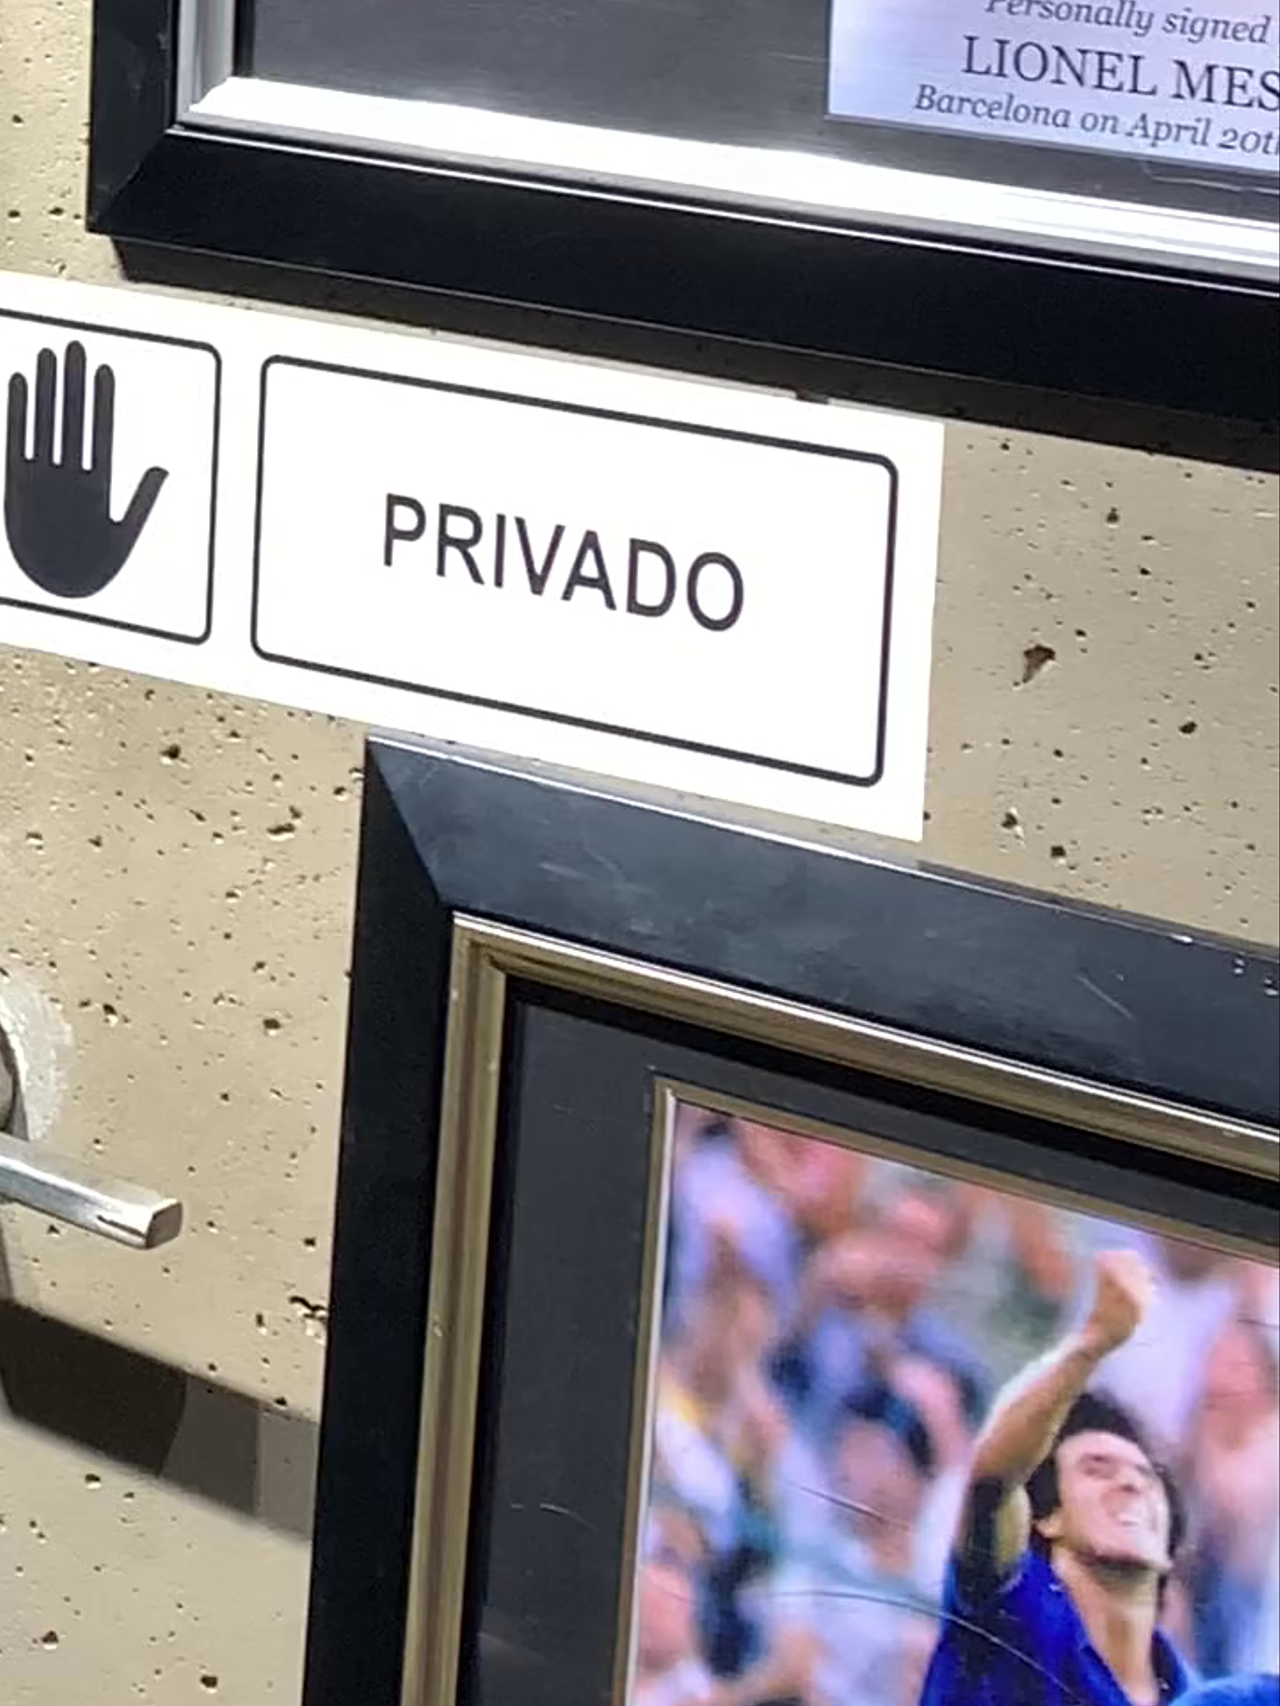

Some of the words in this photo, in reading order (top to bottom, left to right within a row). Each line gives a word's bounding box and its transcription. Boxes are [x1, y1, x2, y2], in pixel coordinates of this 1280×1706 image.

[1162, 8, 1271, 44] signed
[961, 35, 1157, 96] LIONEL
[914, 83, 1071, 129] Barcelona
[1080, 113, 1120, 136] on
[1125, 113, 1210, 148] April
[1219, 126, 1280, 156] 20t
[382, 492, 745, 632] PRIVADO
